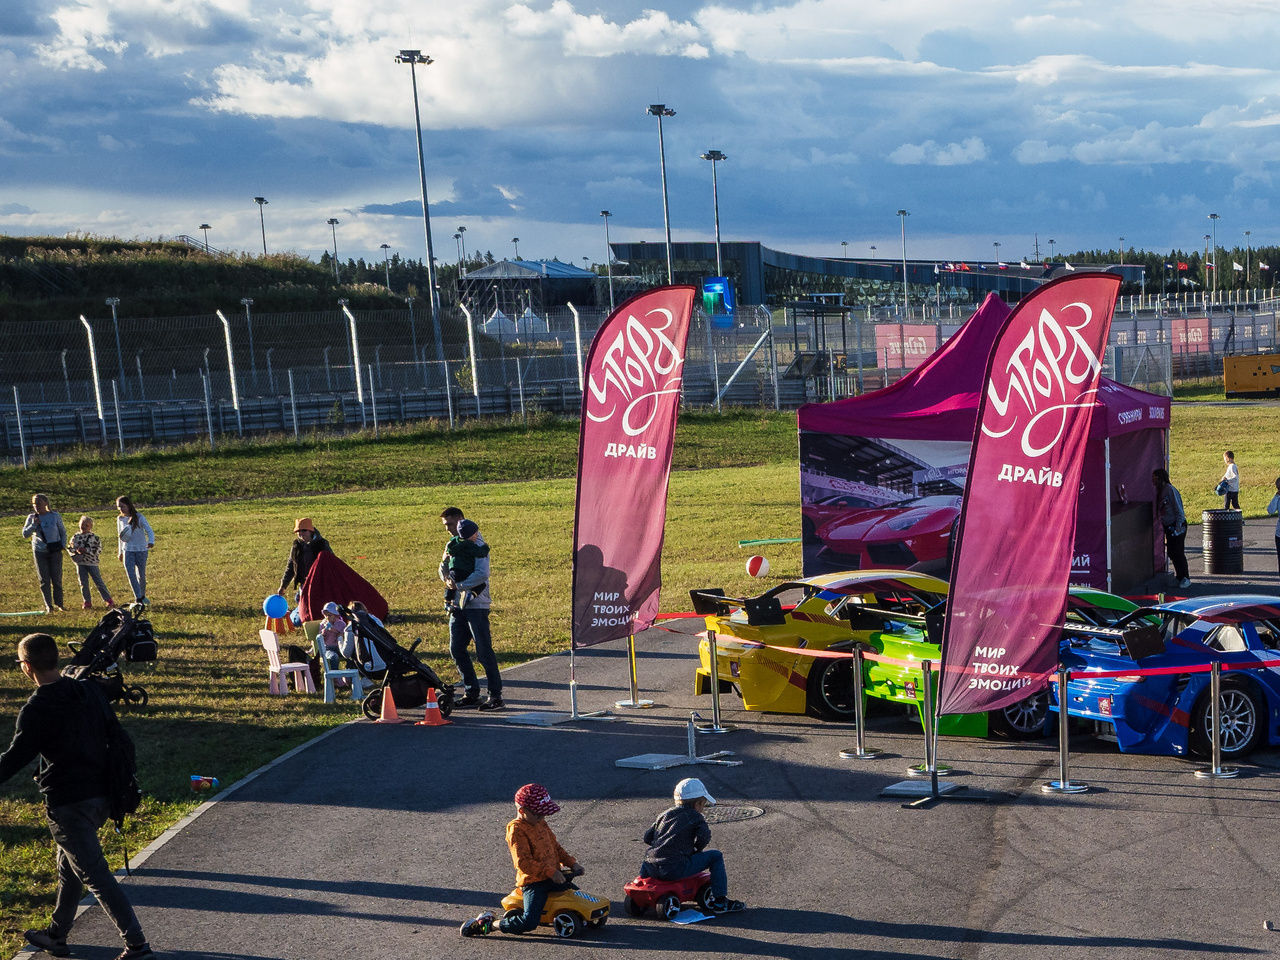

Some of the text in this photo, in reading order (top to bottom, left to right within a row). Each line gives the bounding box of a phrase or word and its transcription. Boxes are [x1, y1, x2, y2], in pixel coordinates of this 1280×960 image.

[604, 443, 656, 460] ДРАЙВ
[997, 464, 1063, 488] ДРАЙВ
[594, 592, 620, 601] МИР
[593, 605, 630, 614] ТВОИХ
[974, 646, 1006, 659] МИР
[972, 662, 1020, 676] ТВОИХ
[968, 675, 1032, 691] ЭМОЦИЙ
